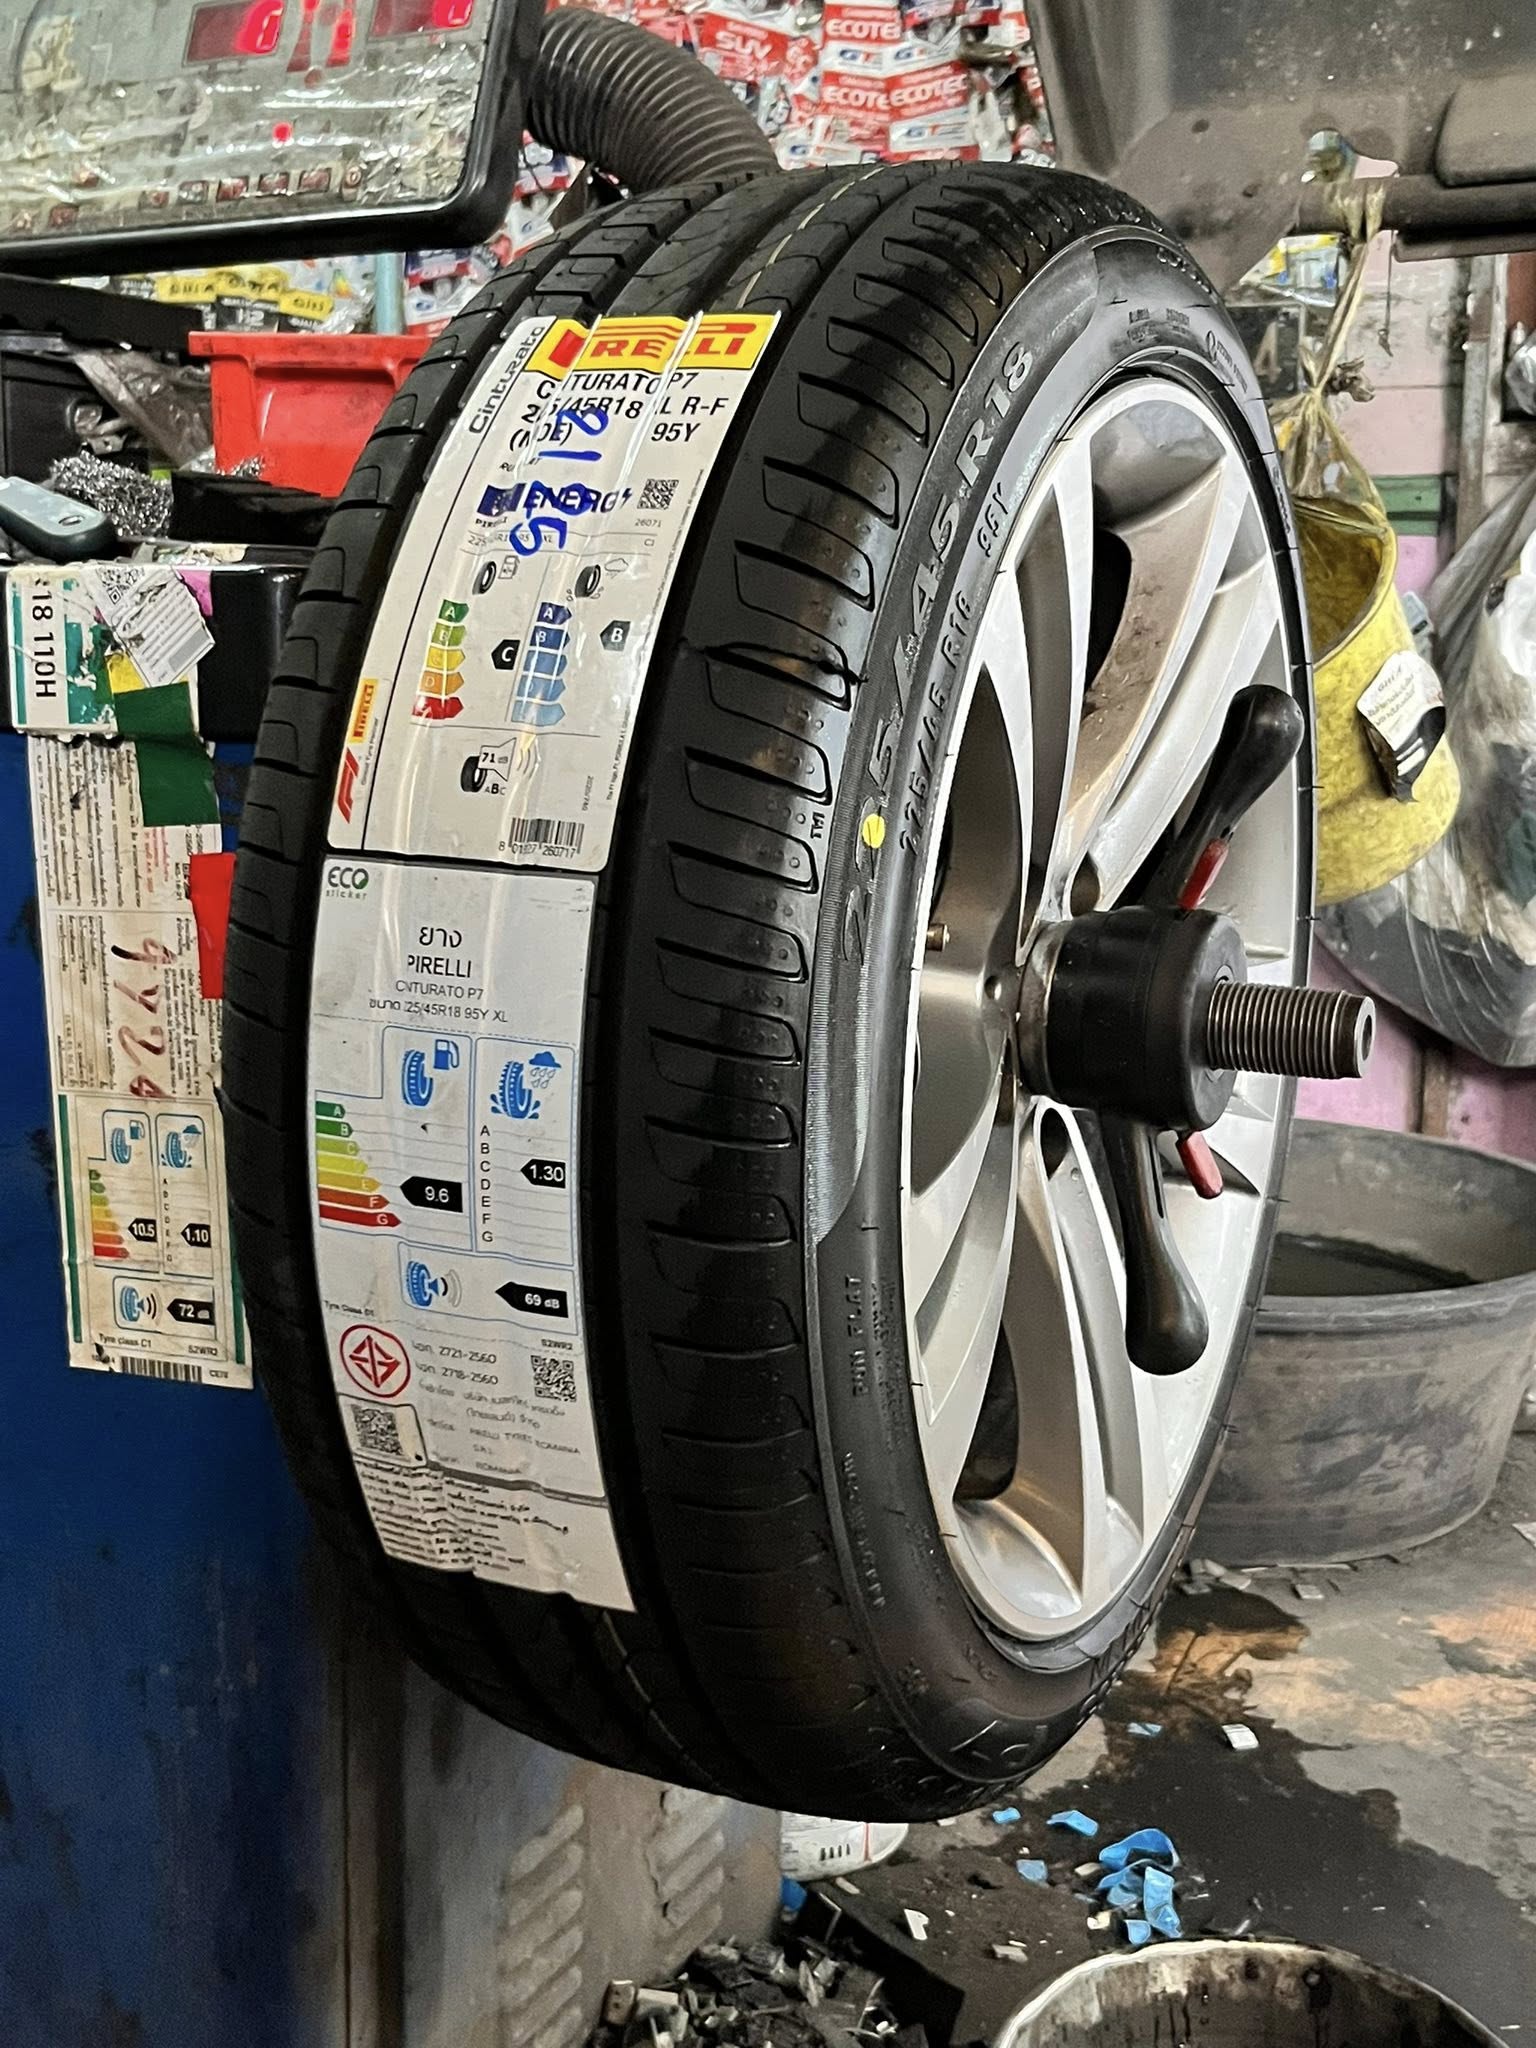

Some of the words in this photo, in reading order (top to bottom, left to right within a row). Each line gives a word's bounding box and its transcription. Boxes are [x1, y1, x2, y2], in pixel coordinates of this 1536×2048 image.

[715, 31, 773, 59] SUV
[468, 326, 546, 434] Cinturato
[681, 396, 730, 417] R-F
[650, 422, 701, 442] 95Y
[444, 607, 457, 618] A
[543, 607, 554, 620] A
[610, 628, 624, 644] B
[500, 647, 515, 663] C
[33, 631, 57, 698] 110H
[482, 752, 496, 764] 71
[498, 841, 506, 852] 8
[542, 844, 577, 859] 260717
[327, 865, 370, 890] ECO
[325, 889, 368, 899] sticker
[418, 926, 463, 948] ยาง
[408, 954, 472, 978] PIRELLI
[466, 987, 485, 1001] P7
[463, 1007, 488, 1020] 95Y
[491, 1010, 509, 1023] XL
[333, 1107, 342, 1116] A
[340, 1125, 350, 1136] B
[480, 1125, 491, 1137] A
[480, 1143, 491, 1155] B
[480, 1161, 491, 1173] C
[528, 1164, 565, 1183] 1.30
[480, 1179, 491, 1191] D
[424, 1186, 450, 1203] 9.6
[481, 1196, 491, 1207] E
[369, 1197, 379, 1208] F
[377, 1213, 389, 1225] G
[482, 1213, 492, 1225] F
[132, 1221, 155, 1237] 10.5
[184, 1226, 208, 1242] 1.10
[482, 1231, 494, 1243] G
[525, 1293, 542, 1306] 69
[544, 1298, 560, 1310] dB
[179, 1304, 195, 1318] 72
[98, 1333, 117, 1345] Tyre
